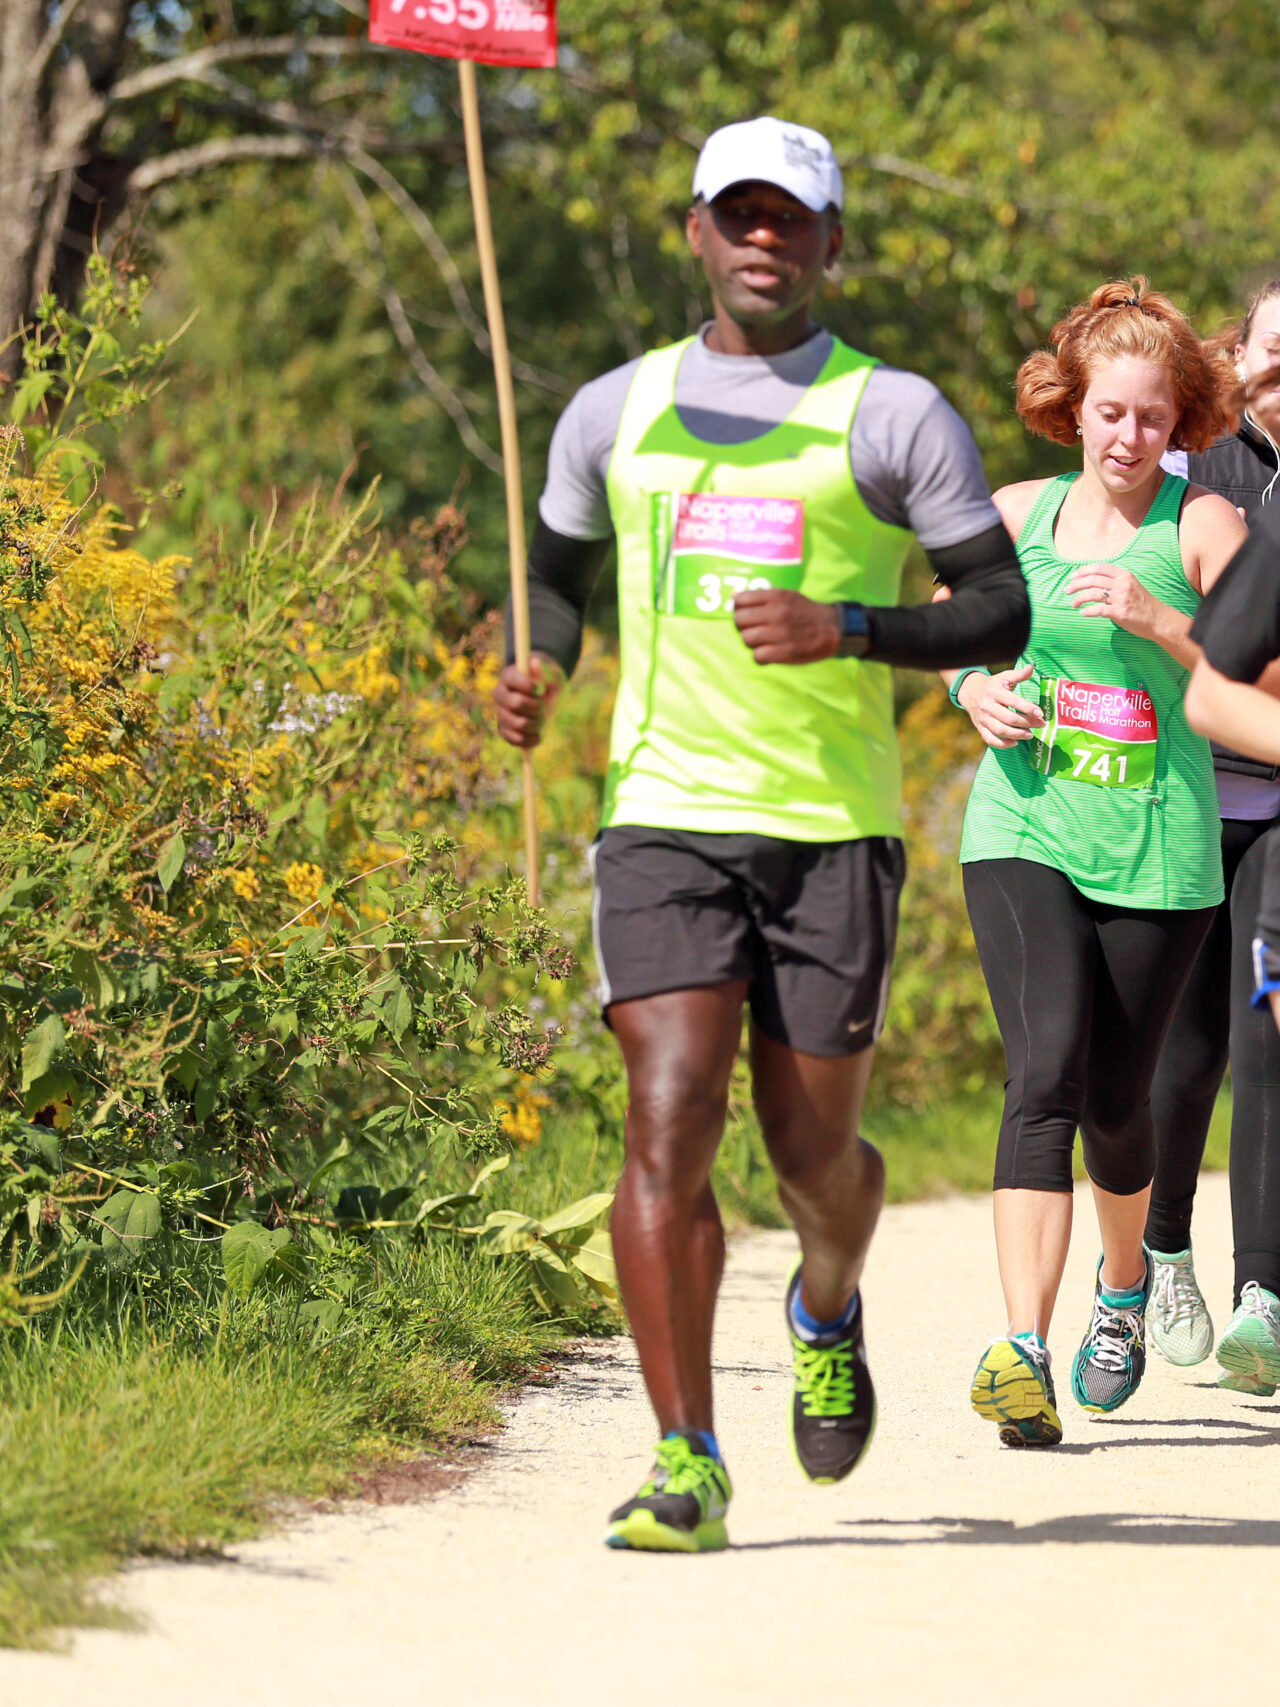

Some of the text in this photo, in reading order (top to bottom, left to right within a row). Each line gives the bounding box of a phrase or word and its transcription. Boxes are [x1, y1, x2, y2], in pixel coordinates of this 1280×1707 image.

[1061, 685, 1152, 711] Naperville
[1059, 701, 1097, 722] Trails
[1099, 716, 1152, 728] Marathon
[1101, 706, 1122, 718] Half
[1072, 748, 1128, 783] 741
